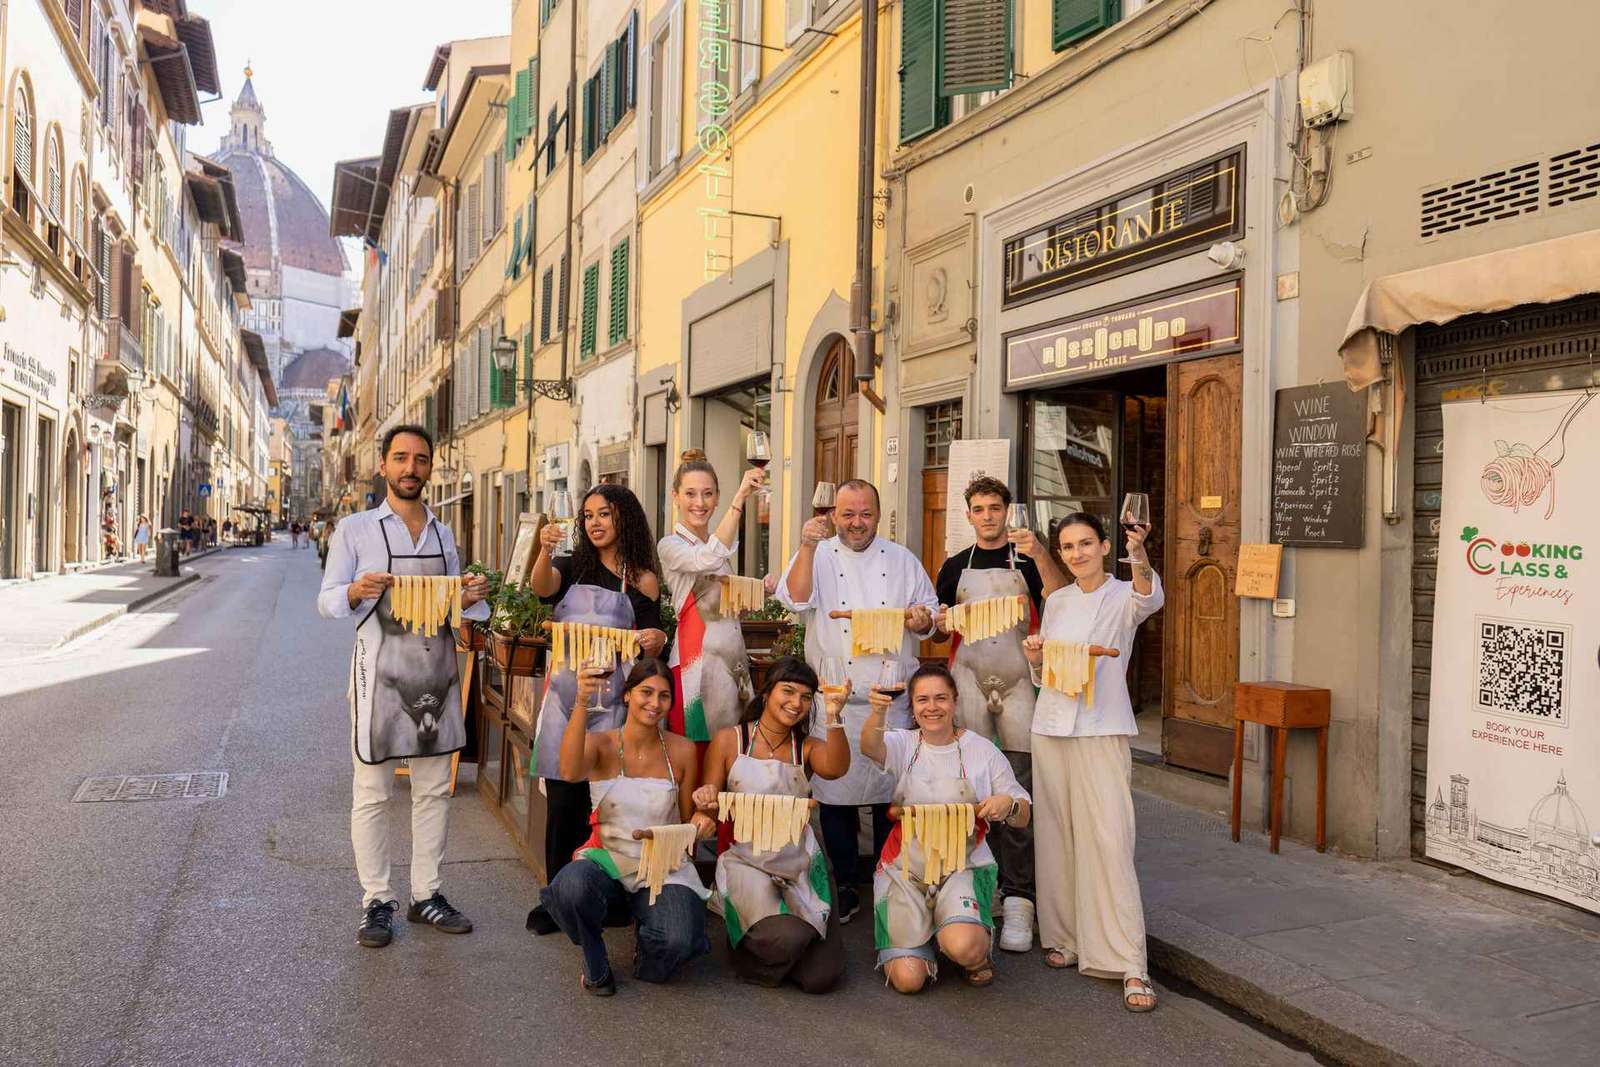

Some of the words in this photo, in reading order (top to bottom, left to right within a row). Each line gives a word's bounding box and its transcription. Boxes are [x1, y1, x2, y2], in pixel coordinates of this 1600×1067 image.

[1041, 199, 1185, 273] RISTORANTE
[1293, 395, 1331, 417] WINE
[1288, 422, 1338, 443] WINDOW
[1276, 446, 1302, 459] WINE
[1275, 460, 1303, 475] Aperol
[1311, 458, 1340, 474] Spritz
[1275, 474, 1294, 489] Hugo
[1310, 473, 1340, 487] Spritz
[1274, 486, 1306, 497] Limoncello
[1309, 485, 1339, 499] Spritz
[1274, 497, 1314, 512] Experience
[1322, 501, 1333, 515] of
[1275, 512, 1293, 522] Wine
[1275, 524, 1290, 537] Just
[1554, 564, 1568, 579] &
[1486, 721, 1512, 734] BOOK
[1514, 727, 1545, 740] YOUR
[1471, 729, 1530, 750] EXPERIENCE
[1533, 743, 1564, 756] HERE
